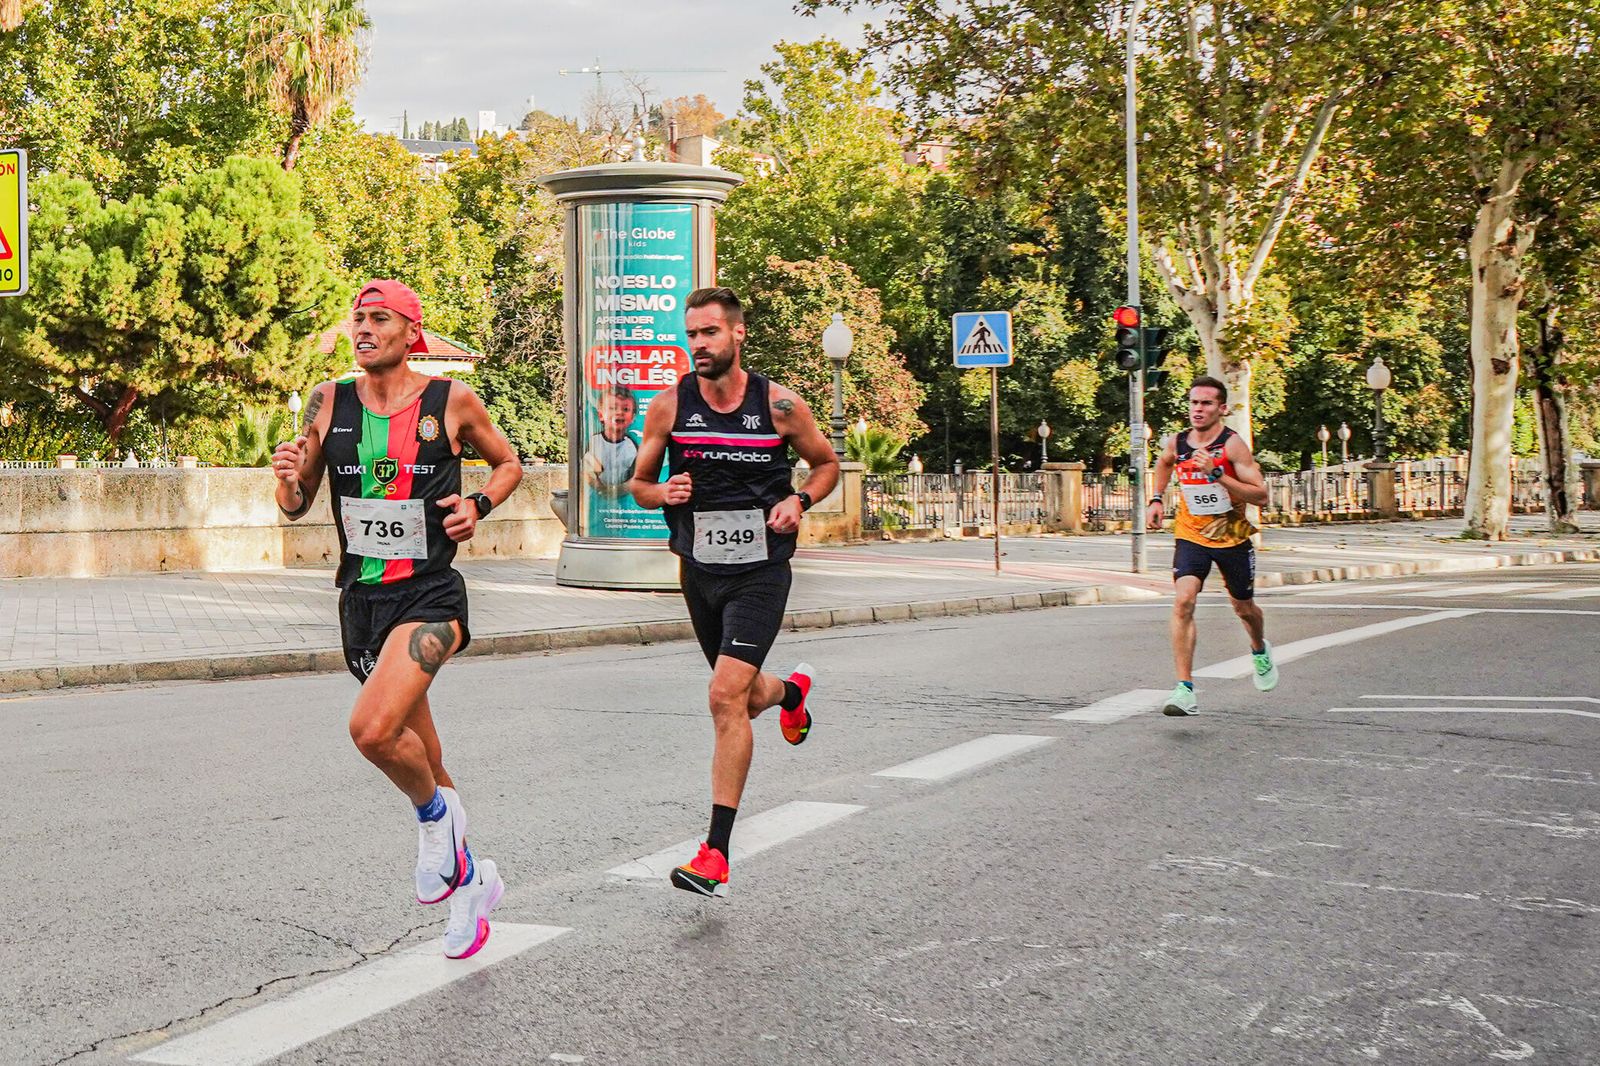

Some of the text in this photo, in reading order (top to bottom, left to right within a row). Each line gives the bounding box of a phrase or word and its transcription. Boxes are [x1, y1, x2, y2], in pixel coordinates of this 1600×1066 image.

[600, 227, 676, 240] The Globe
[595, 275, 676, 289] NO ES LO
[595, 295, 677, 312] MISMO
[596, 316, 654, 324] APRENDER
[596, 326, 677, 342] INGLÉS QUE
[595, 350, 676, 364] HABLAR
[596, 366, 678, 385] INGLÉS
[336, 465, 366, 475] LOKI
[403, 464, 436, 475] TEST
[1194, 493, 1218, 505] 566
[359, 519, 405, 538] 736
[704, 529, 755, 546] 1349
